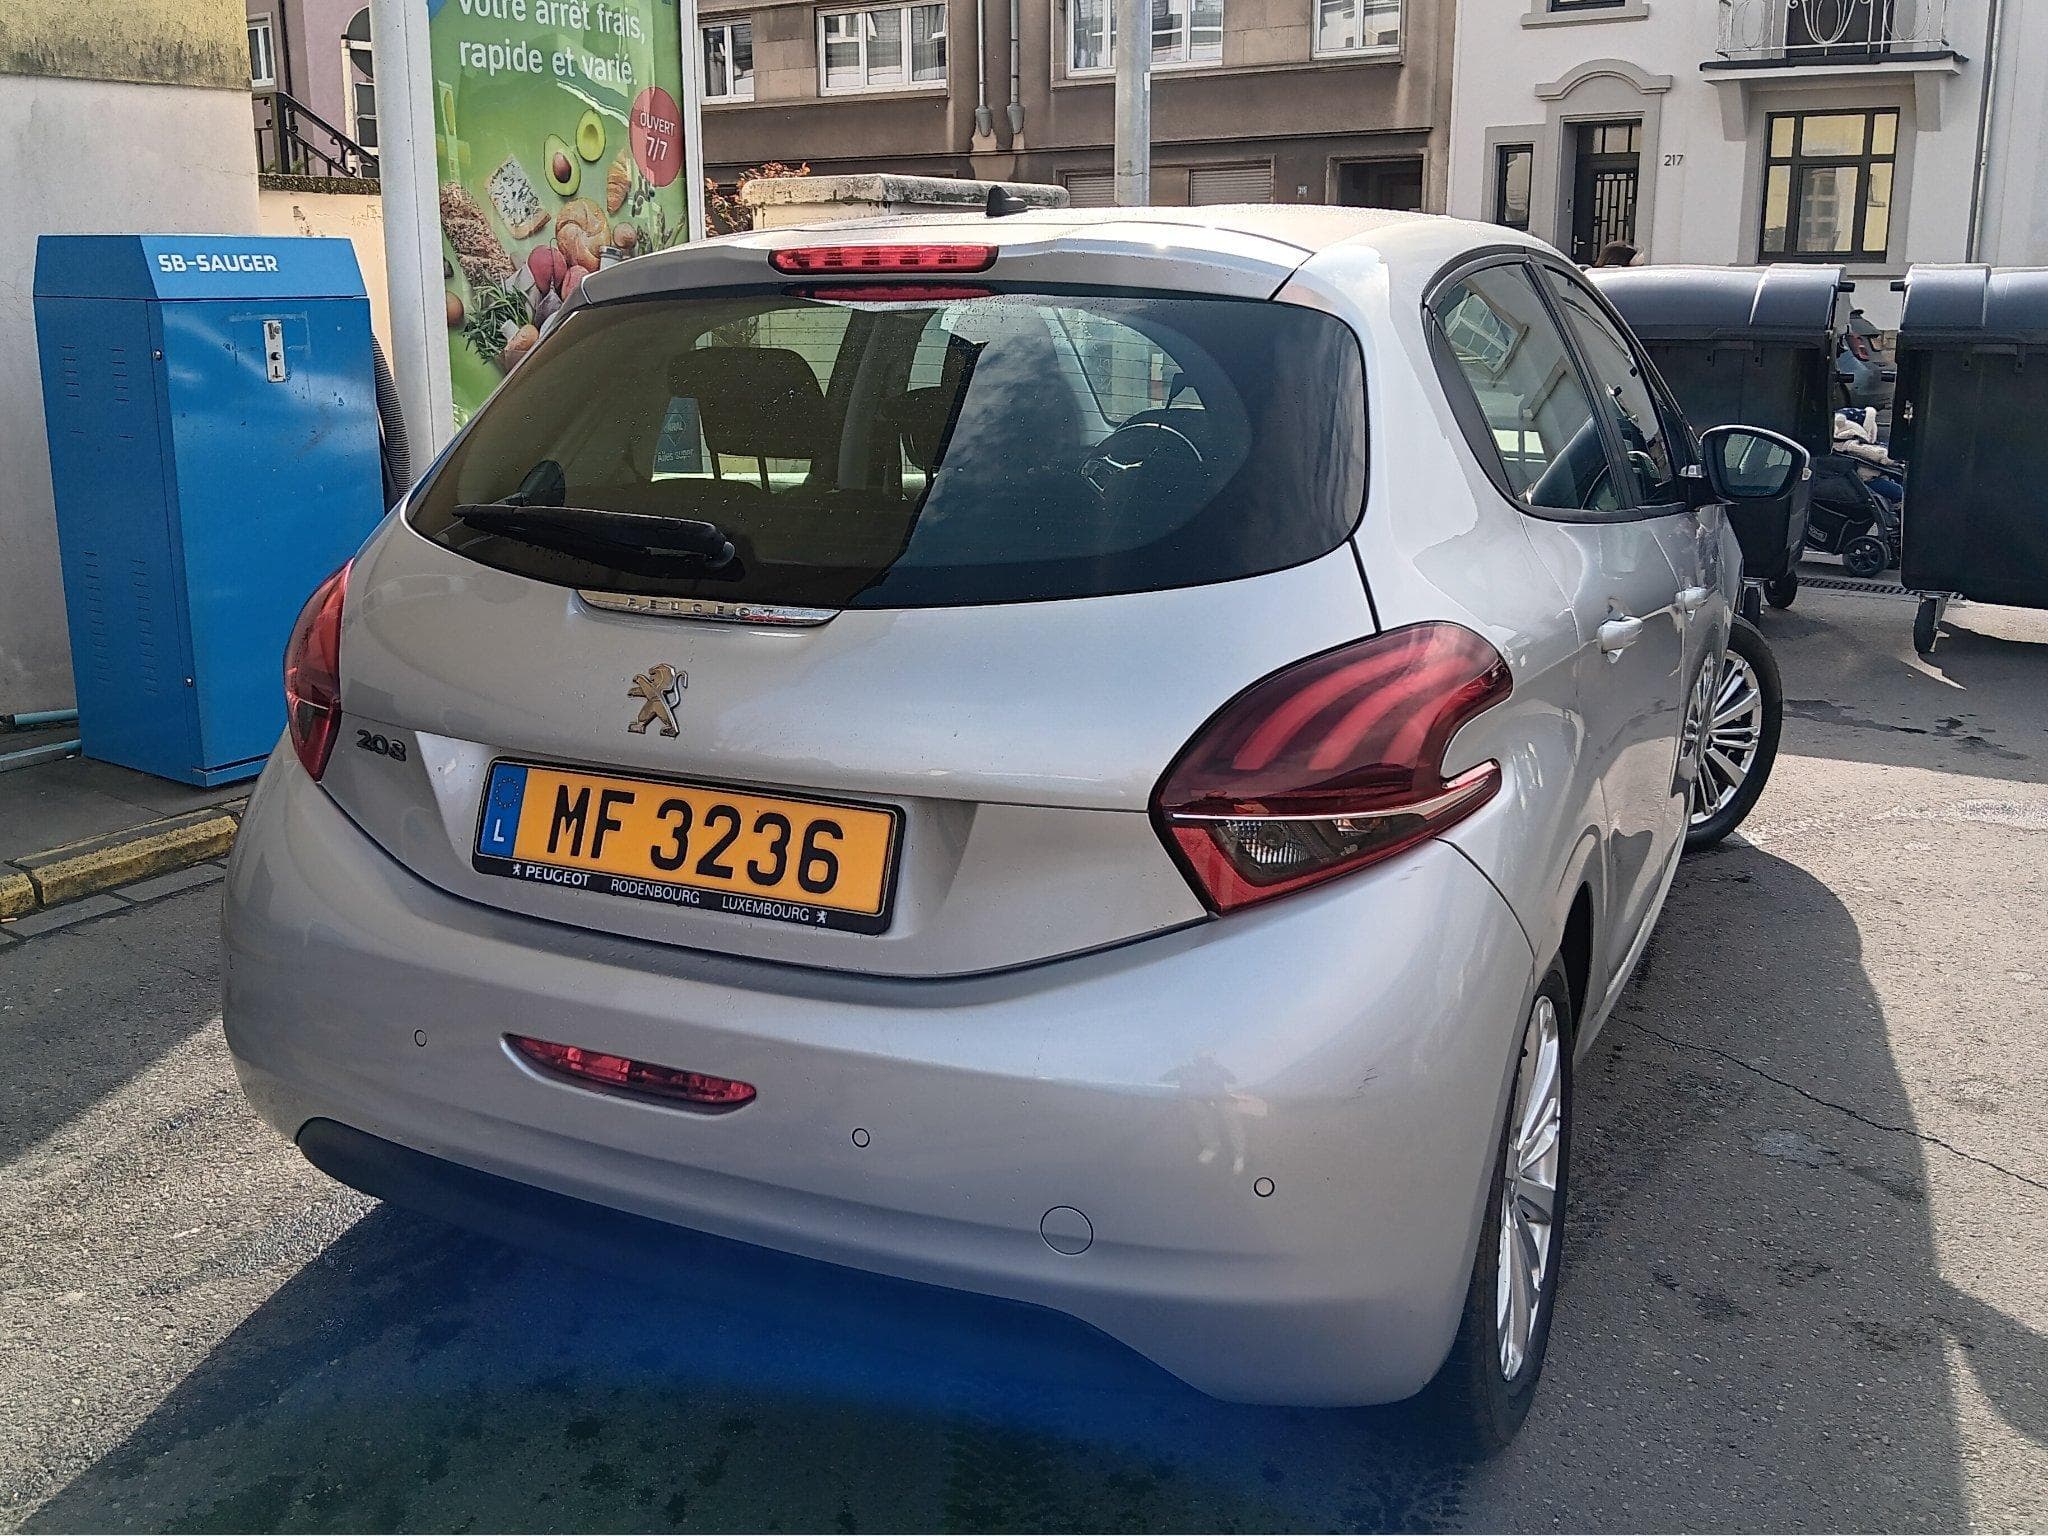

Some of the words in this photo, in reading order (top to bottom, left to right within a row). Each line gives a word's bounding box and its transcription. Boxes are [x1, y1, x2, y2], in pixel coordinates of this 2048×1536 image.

[535, 0, 591, 31] arrêt
[596, 2, 645, 44] frais,
[459, 38, 543, 76] rapide
[552, 46, 576, 78] et
[582, 53, 638, 85] varié.
[640, 112, 676, 137] OUVERT
[646, 136, 668, 161] 7/7
[1663, 154, 1684, 167] 217
[157, 254, 279, 272] SB-SAUGER
[626, 597, 774, 617] PEUGEOT
[356, 729, 407, 762] 208
[493, 818, 504, 843] L
[546, 784, 636, 859] MF
[650, 798, 844, 894] 3236
[525, 865, 591, 887] PEUGEOT
[611, 878, 700, 904] RODENBOURG
[722, 895, 810, 921] LUXEMBOURG
